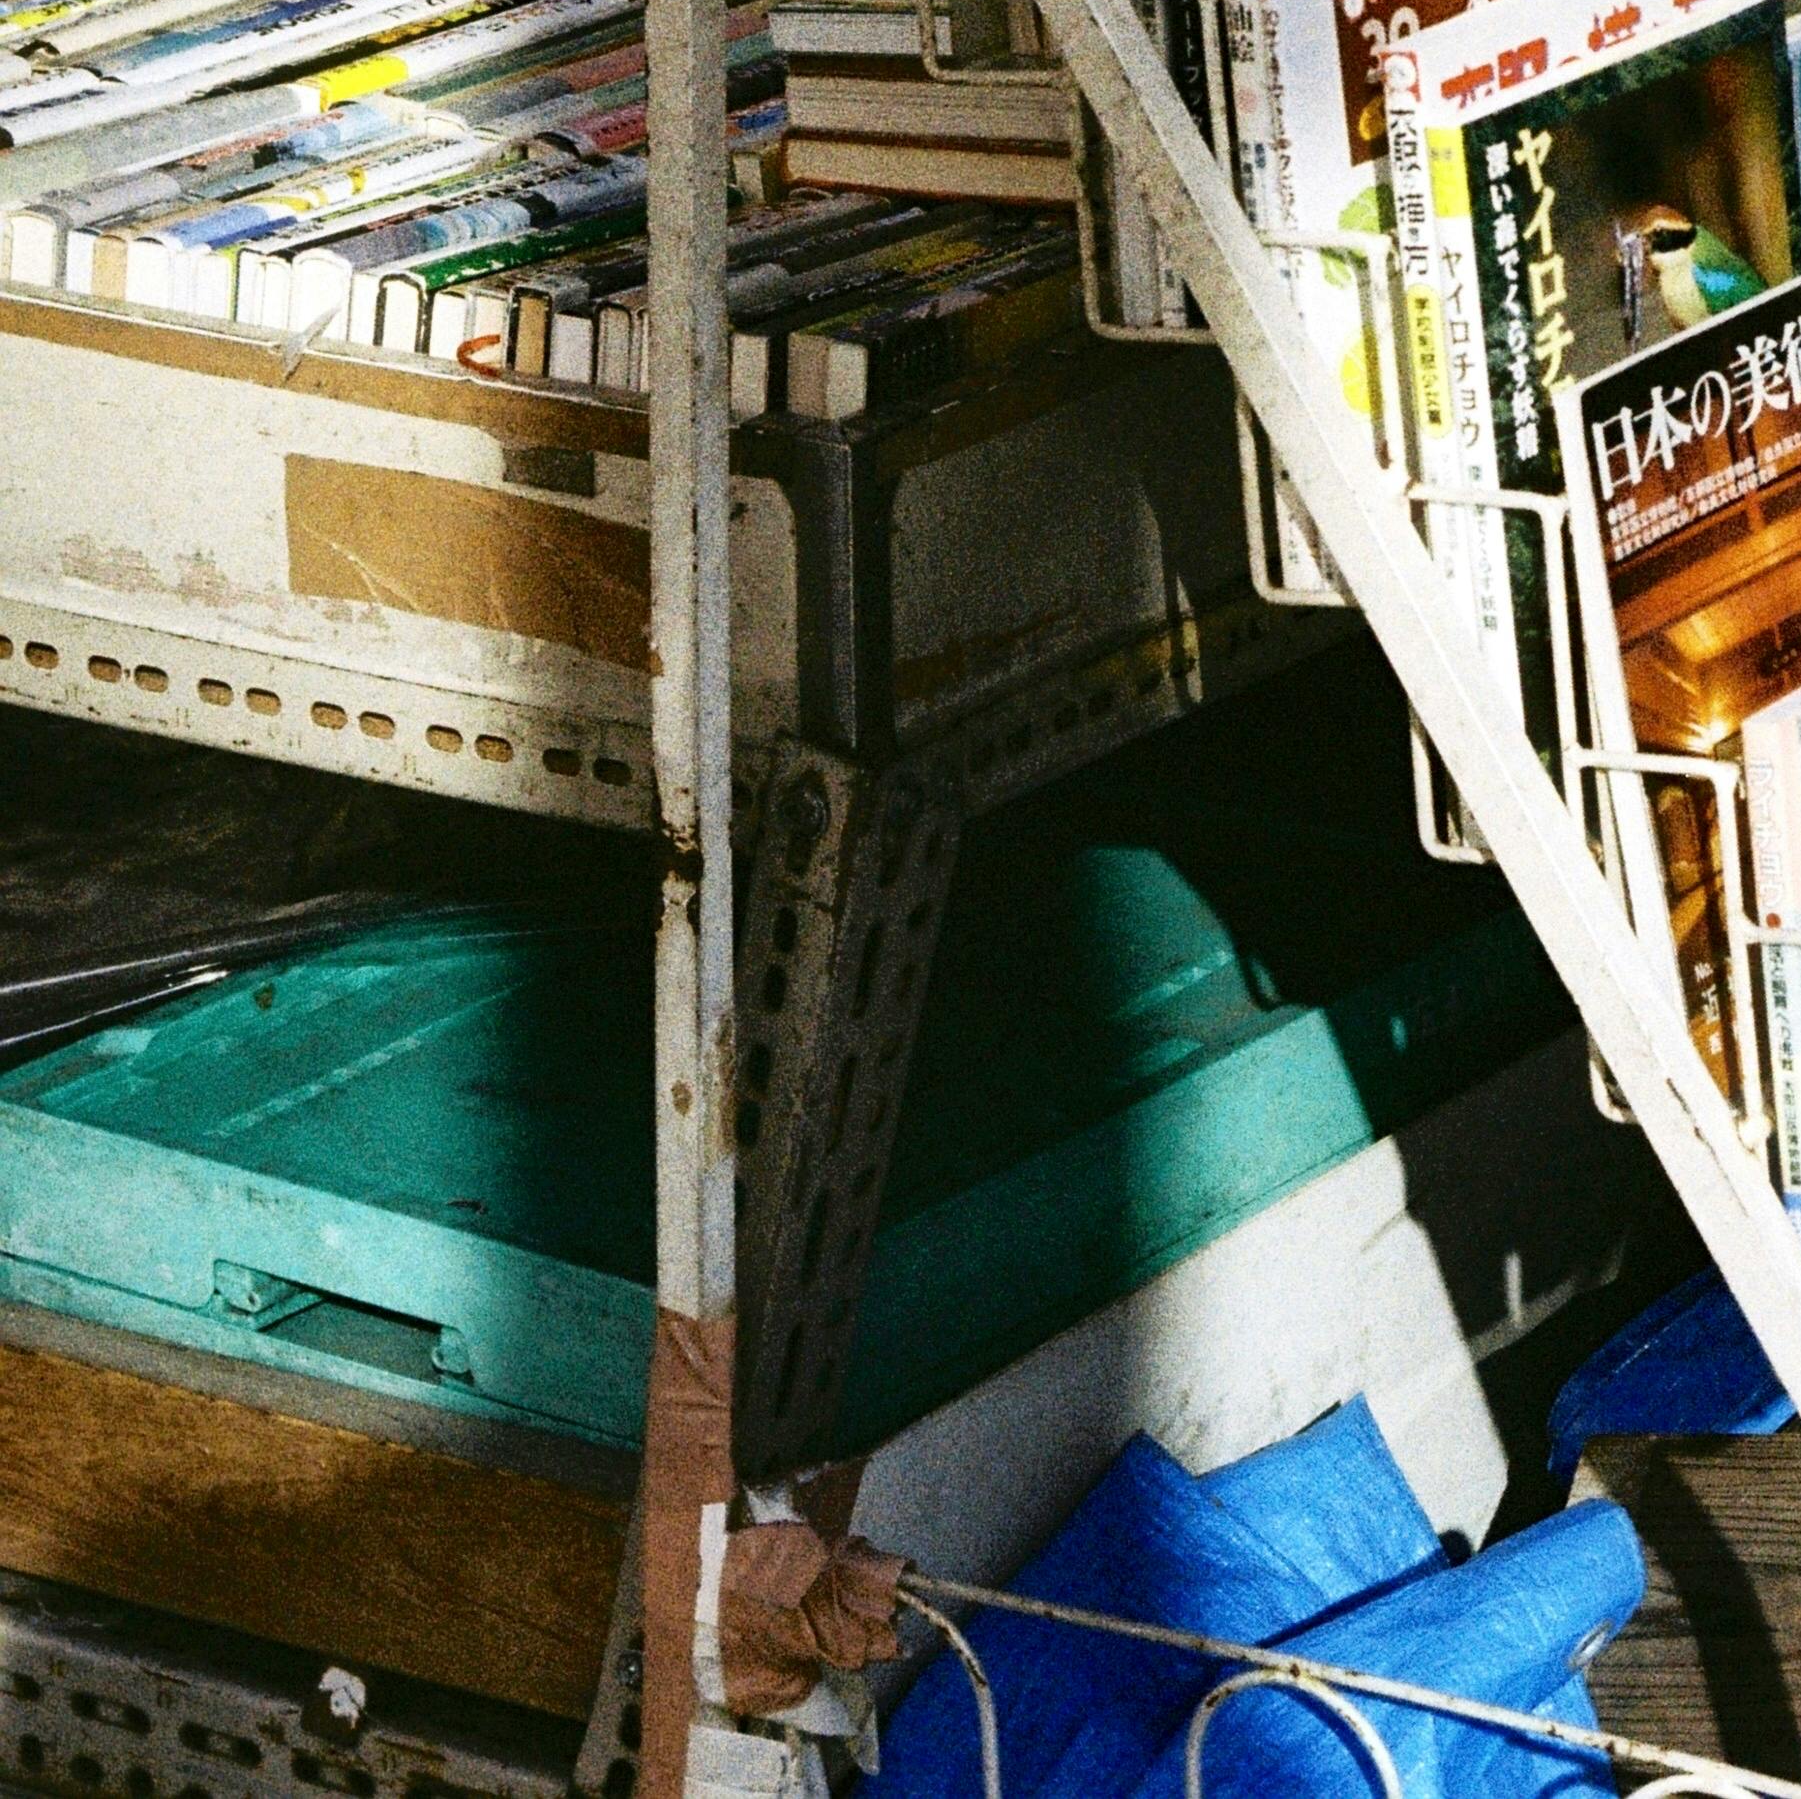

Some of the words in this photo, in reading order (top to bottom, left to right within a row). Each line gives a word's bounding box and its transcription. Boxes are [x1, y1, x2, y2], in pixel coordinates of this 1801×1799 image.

[1440, 245, 1481, 449] ヤイロチョウ
